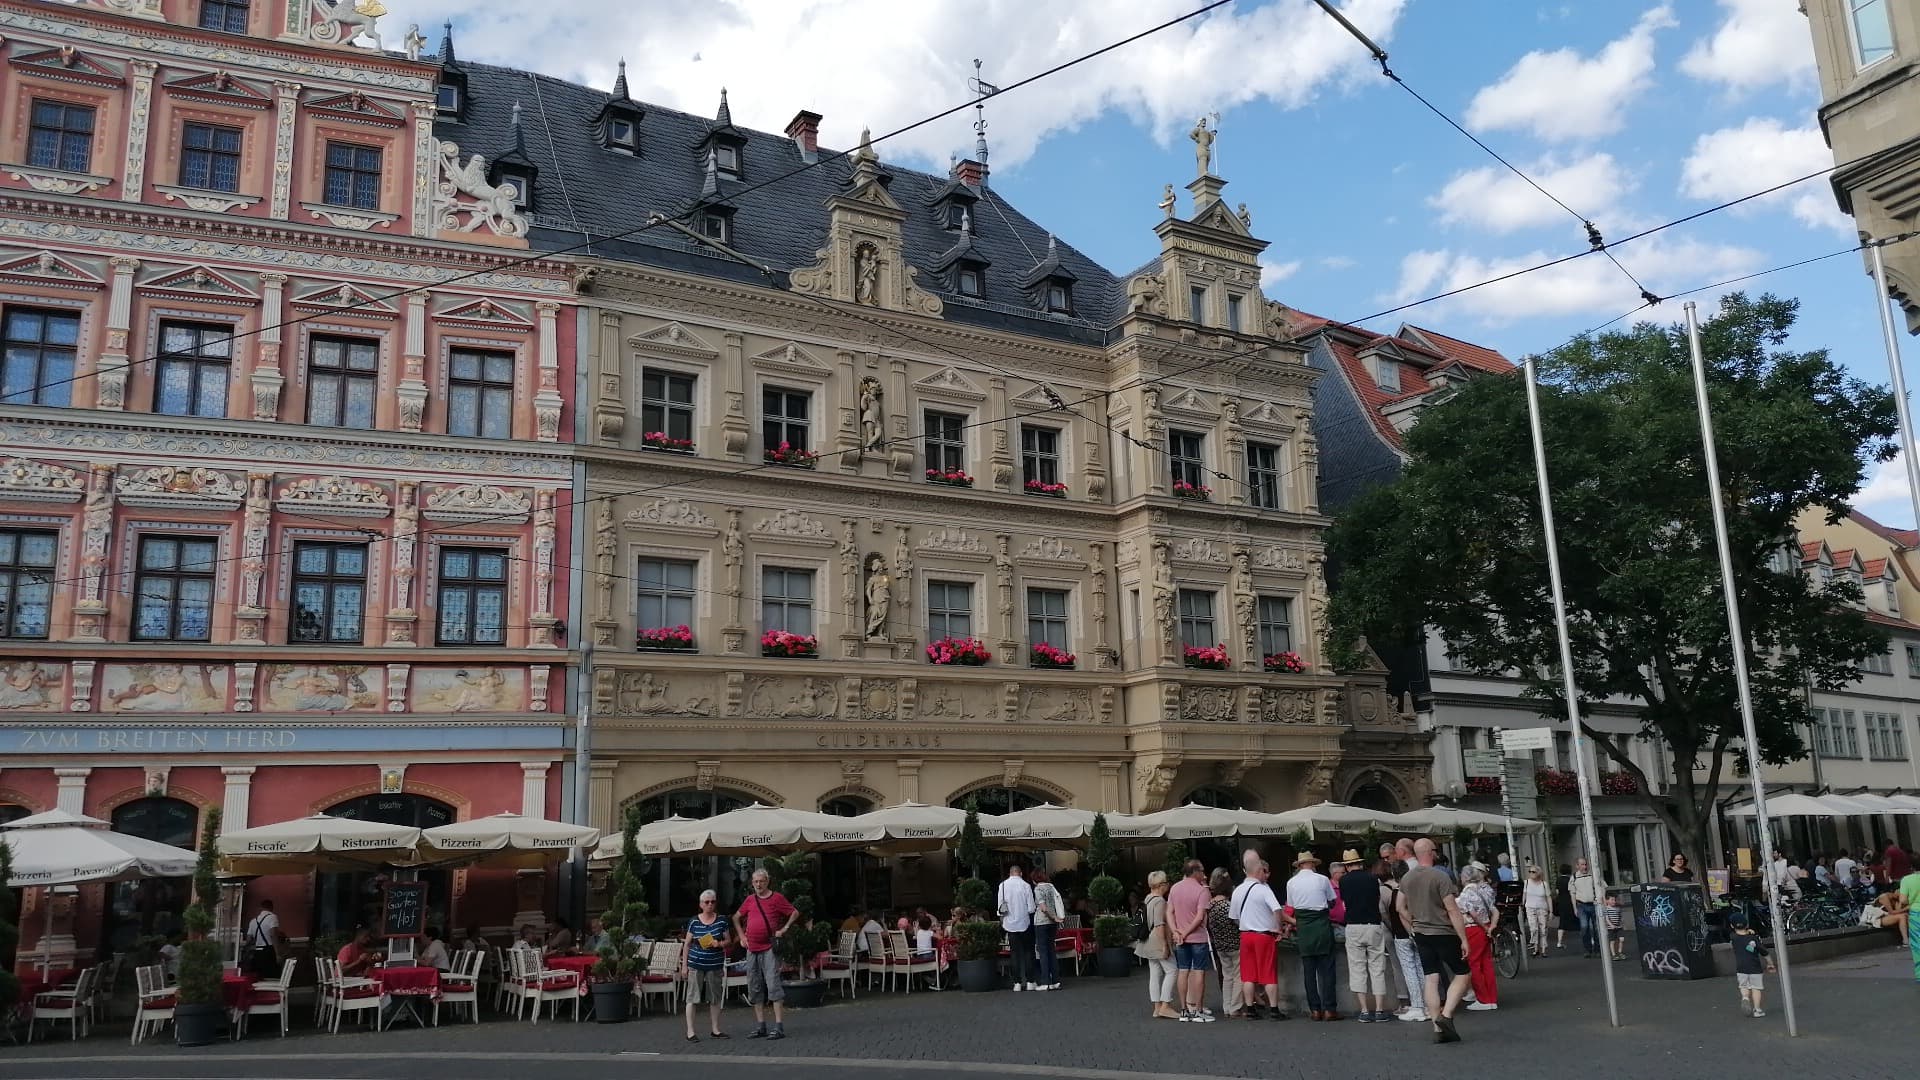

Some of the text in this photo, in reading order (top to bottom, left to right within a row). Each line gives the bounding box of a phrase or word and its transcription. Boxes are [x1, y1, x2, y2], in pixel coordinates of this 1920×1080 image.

[98, 731, 208, 749] BREITEN
[225, 731, 297, 747] HERD
[823, 831, 864, 841] Ristorante
[904, 827, 934, 837] Pizzeria
[342, 837, 398, 849] Ristorante
[441, 838, 482, 848] Pizzeria
[533, 836, 577, 847] Pavarotti
[11, 869, 52, 882] Pizzeria
